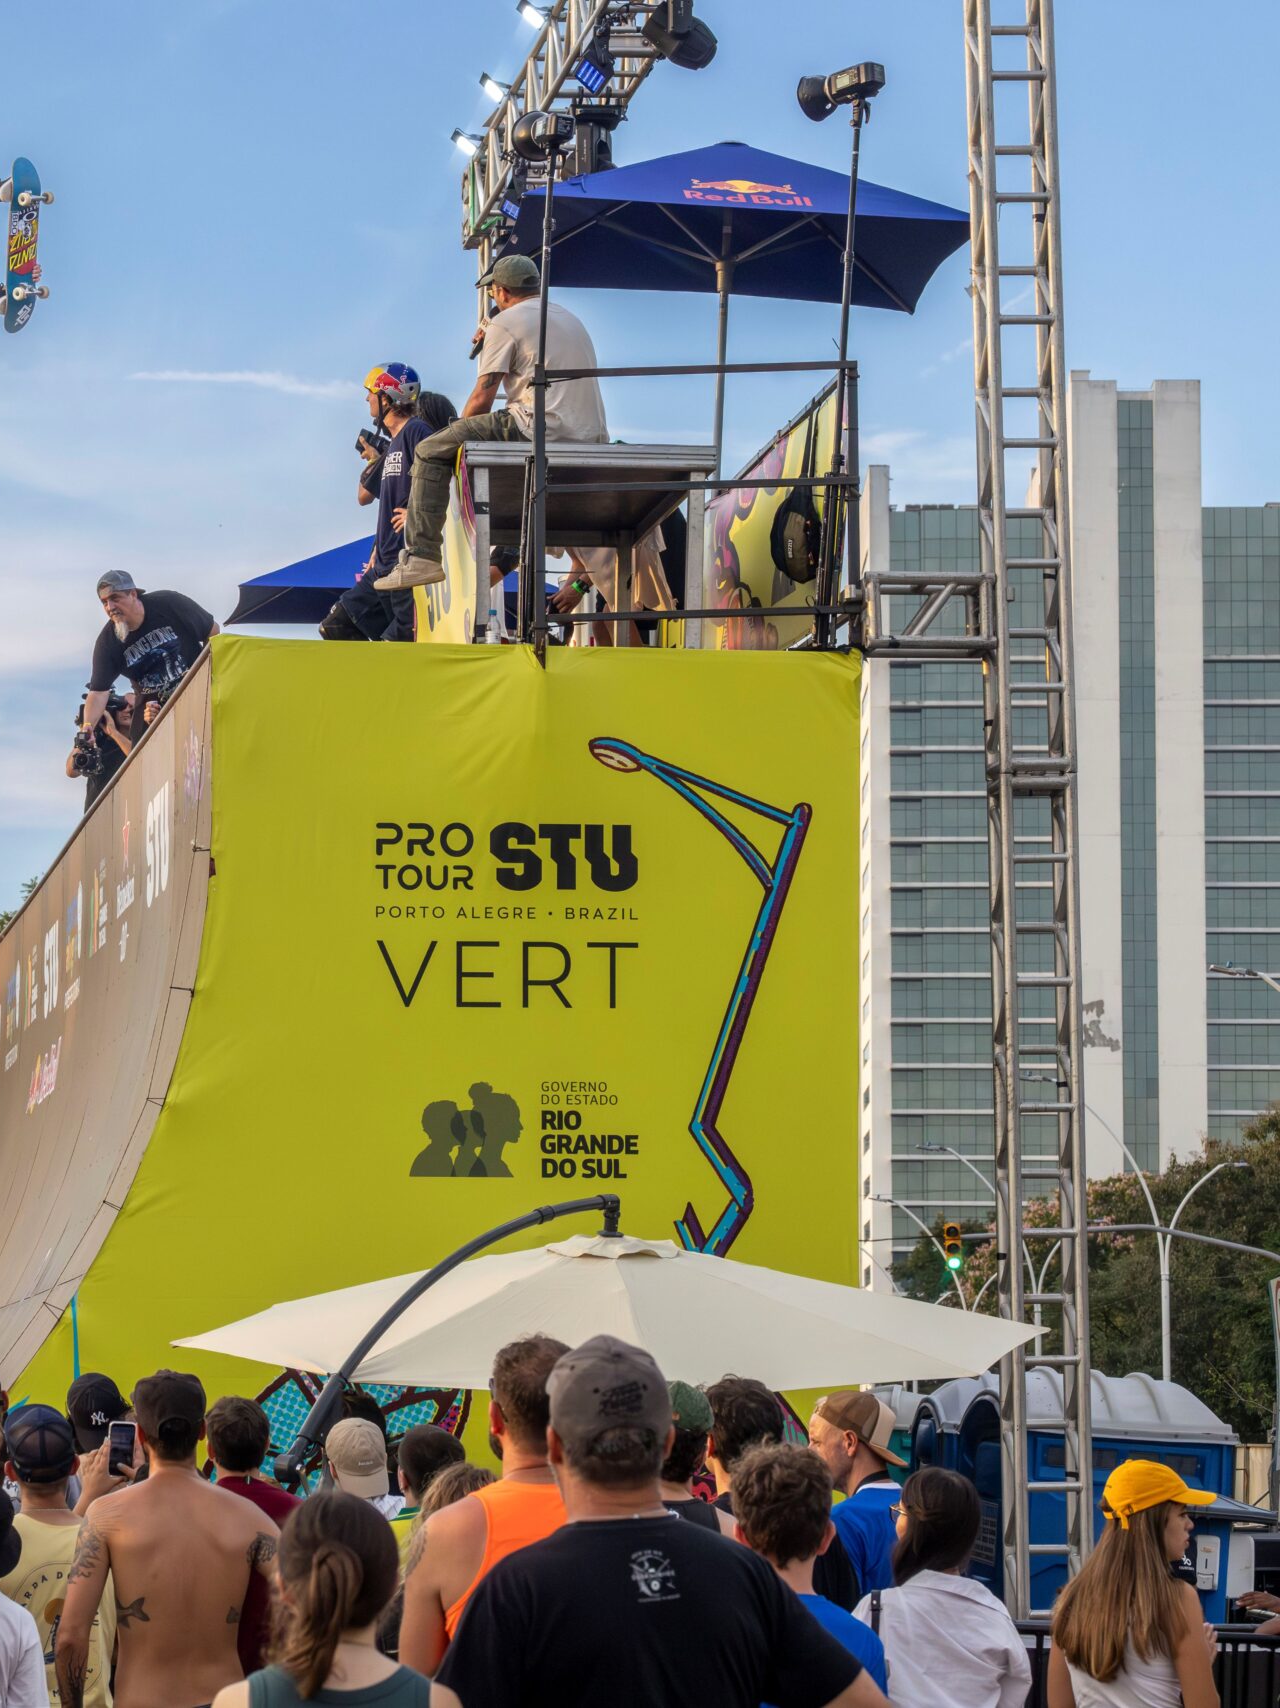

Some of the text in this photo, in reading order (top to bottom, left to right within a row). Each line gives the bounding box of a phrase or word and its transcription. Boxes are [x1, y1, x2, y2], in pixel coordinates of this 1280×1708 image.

[682, 189, 813, 207] Red Bull
[146, 780, 169, 908] STU
[375, 821, 639, 892] PRO STU
[375, 864, 474, 891] TOUR
[375, 906, 639, 921] PORTO ALEGRE BRAZIL
[43, 919, 59, 1020] STU
[376, 939, 639, 1009] VERT
[540, 1081, 608, 1093] GOVERNO
[540, 1094, 619, 1106] DO ESTADO
[540, 1110, 582, 1131] RIO
[540, 1134, 639, 1155] GRANDE
[540, 1159, 627, 1179] DO SUL
